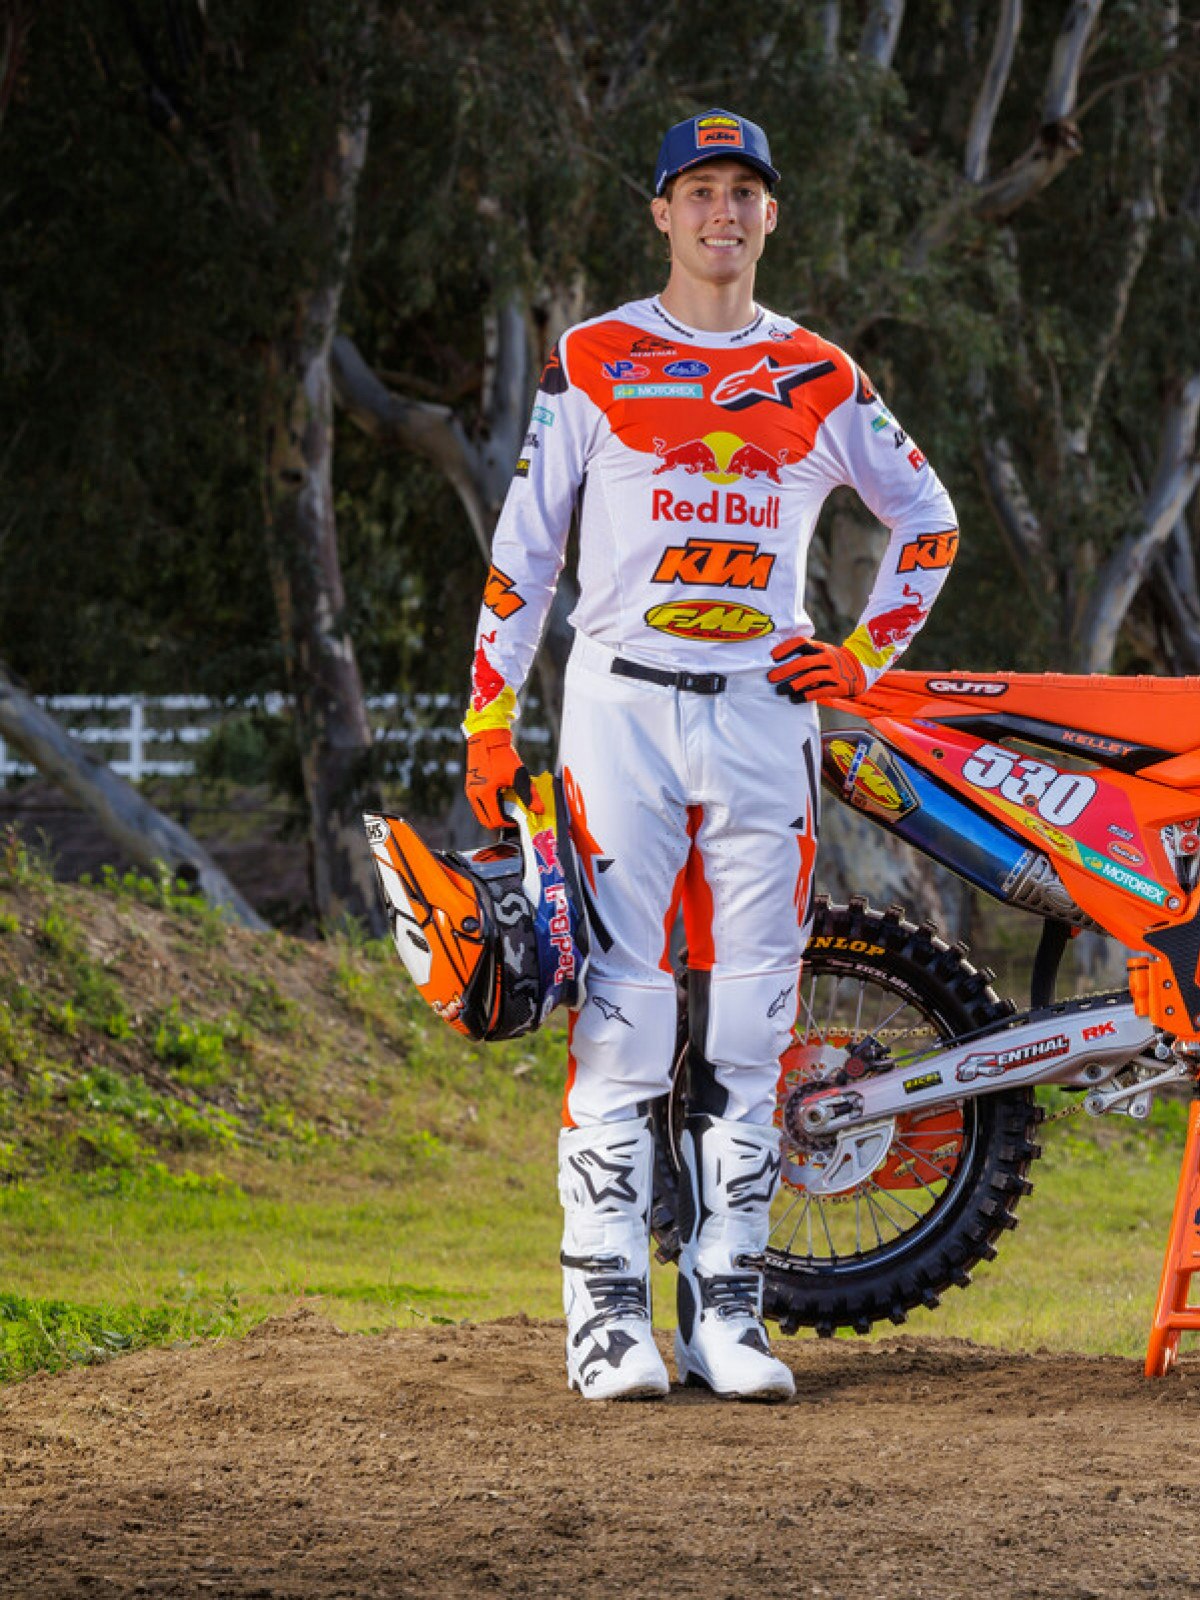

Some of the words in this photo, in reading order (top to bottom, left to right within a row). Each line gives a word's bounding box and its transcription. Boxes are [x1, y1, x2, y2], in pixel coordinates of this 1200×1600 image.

[638, 386, 696, 396] MOTOREX
[652, 488, 719, 524] Red
[725, 492, 780, 529] Bull
[650, 537, 777, 591] KTM
[645, 602, 774, 636] FMF
[927, 680, 1006, 694] GUTS
[1062, 731, 1133, 756] KELLEY
[962, 744, 1097, 827] 530
[1102, 862, 1164, 902] MOTOREX
[545, 883, 571, 935] Bull
[550, 936, 576, 986] Red
[806, 937, 885, 955] NLOP
[1082, 1021, 1117, 1042] RK
